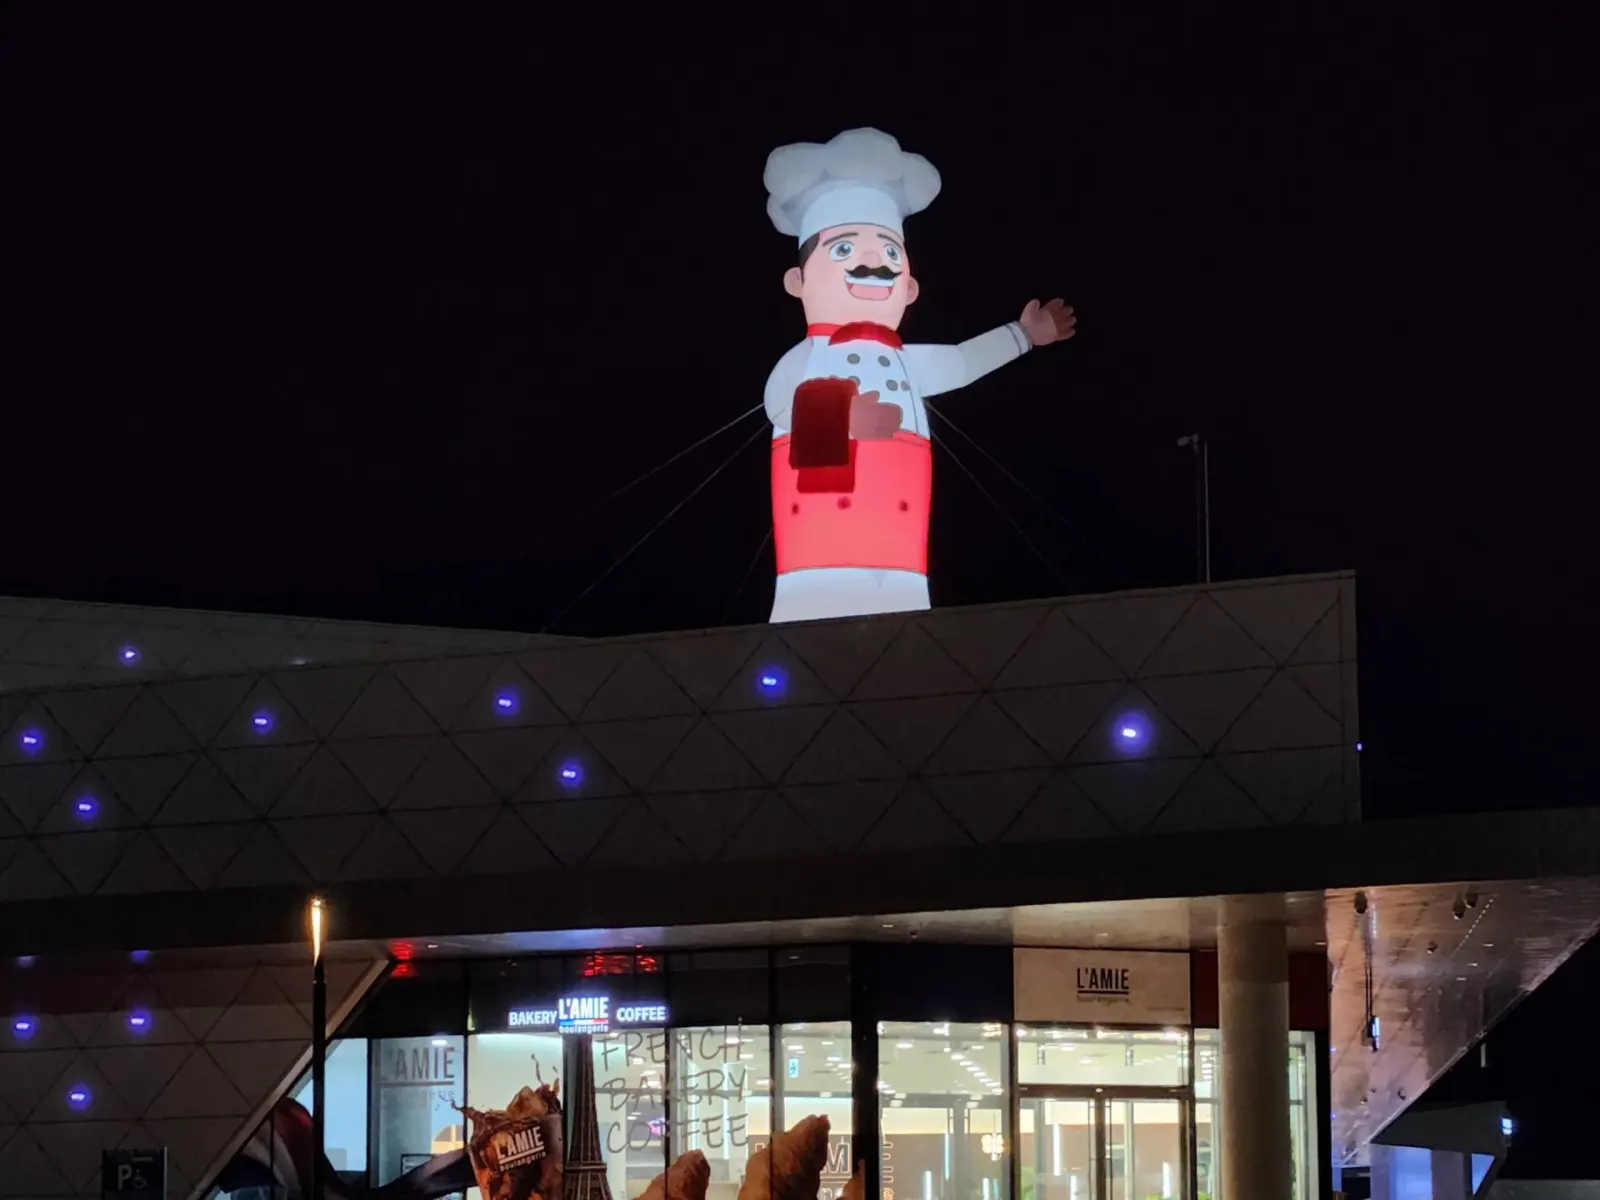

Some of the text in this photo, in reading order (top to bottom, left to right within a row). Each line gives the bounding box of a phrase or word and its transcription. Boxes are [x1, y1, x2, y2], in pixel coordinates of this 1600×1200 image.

[1076, 967, 1130, 990] L'AMIE
[508, 1011, 557, 1026] BAKERY
[558, 997, 609, 1020] L'AMIE
[616, 1006, 666, 1022] COFFEE
[597, 1024, 744, 1072] FRENCH
[118, 1164, 132, 1191] P
